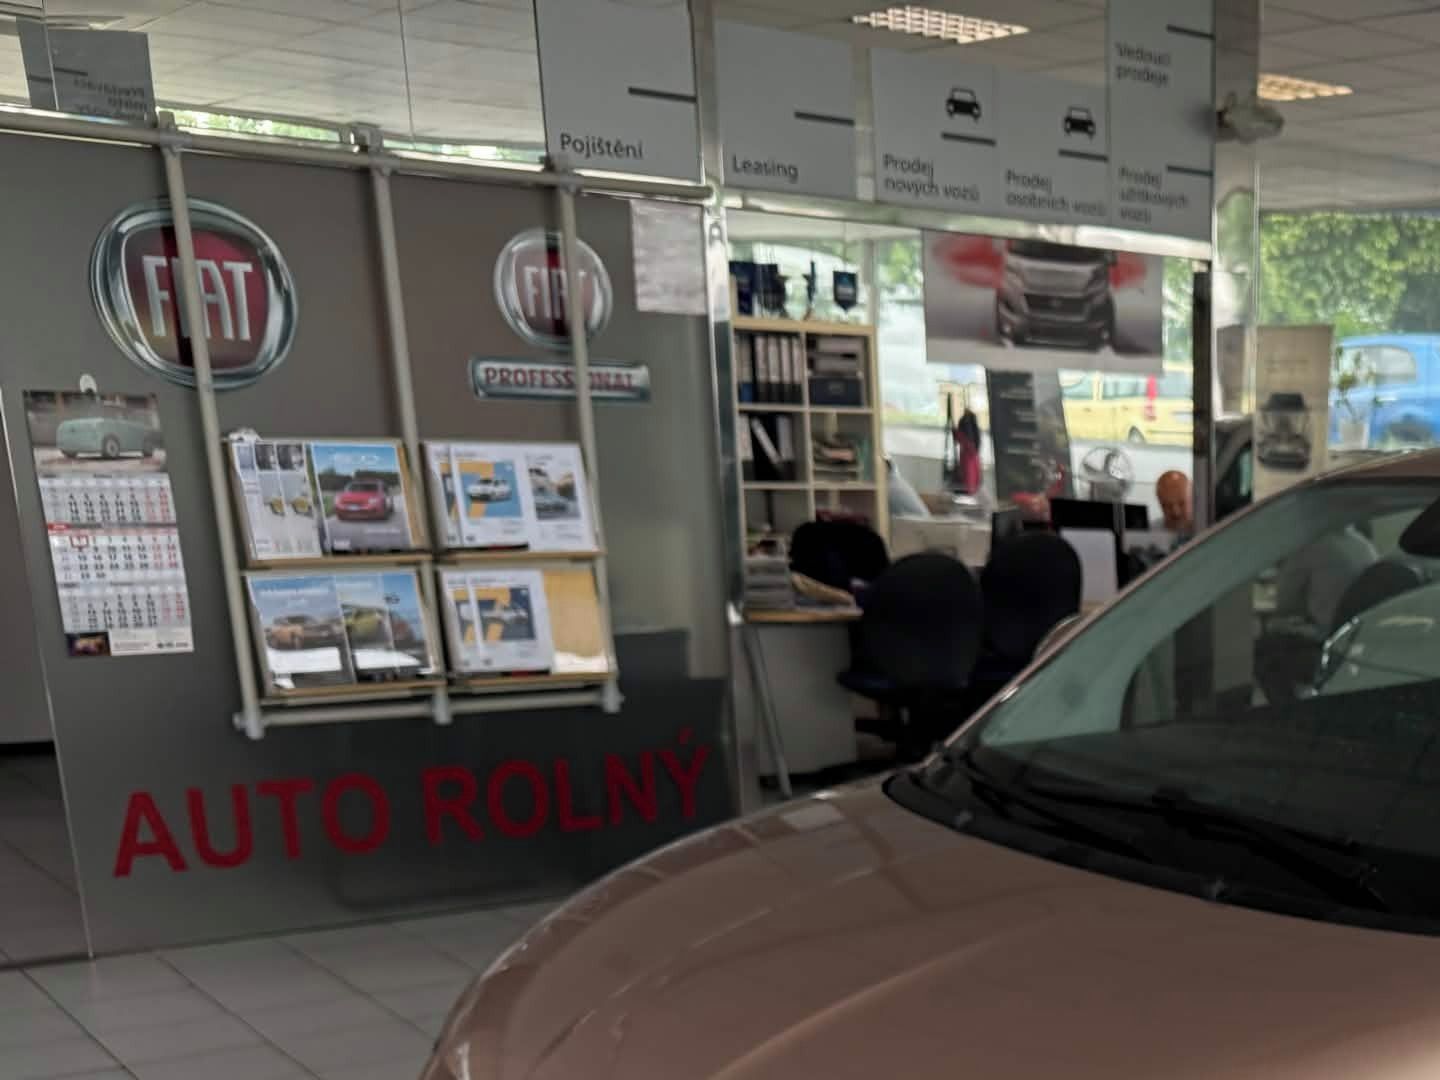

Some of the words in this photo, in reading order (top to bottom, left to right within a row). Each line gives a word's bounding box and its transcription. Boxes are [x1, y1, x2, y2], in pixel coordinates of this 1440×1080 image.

[559, 132, 643, 159] Pojištění
[732, 156, 799, 183] Leasing
[883, 153, 934, 178] Prodej
[1005, 168, 1052, 190] Prodej
[142, 255, 254, 341] FIAT
[484, 366, 634, 390] PROFESSONAL
[113, 772, 392, 877] AUTO
[421, 728, 711, 845] ROLNÝ
